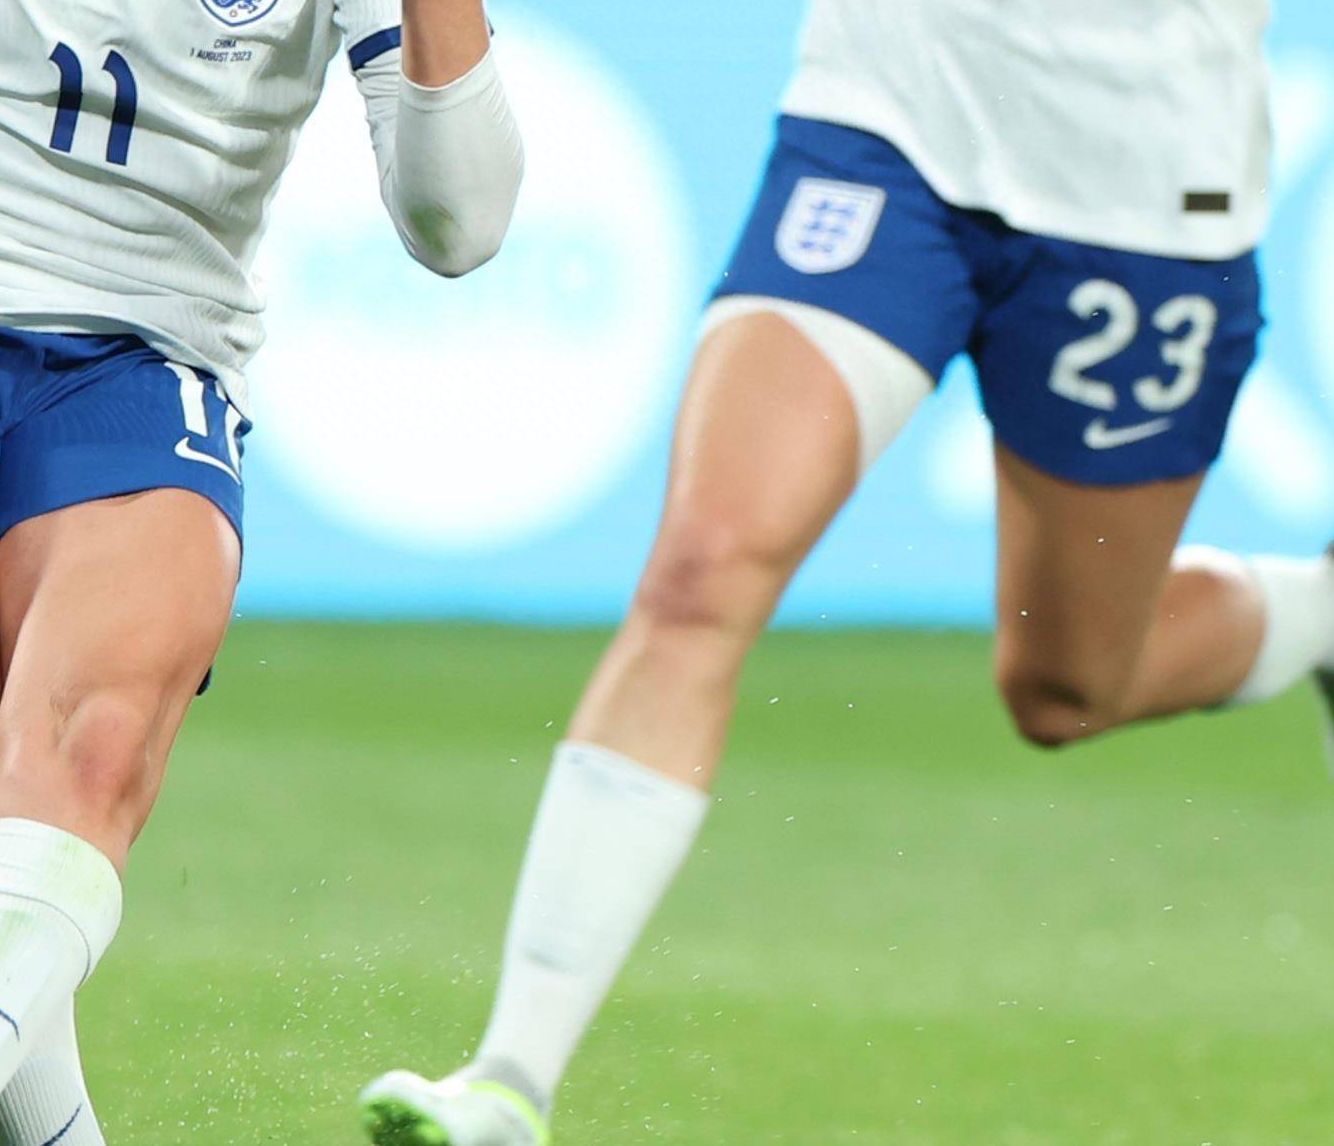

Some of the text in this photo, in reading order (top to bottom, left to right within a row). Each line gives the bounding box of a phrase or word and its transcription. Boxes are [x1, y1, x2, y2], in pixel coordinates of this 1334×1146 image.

[196, 49, 228, 62] AUGUST
[230, 51, 252, 62] 2023
[213, 38, 237, 49] CHINA
[49, 41, 137, 167] 11
[1047, 279, 1218, 413] 23
